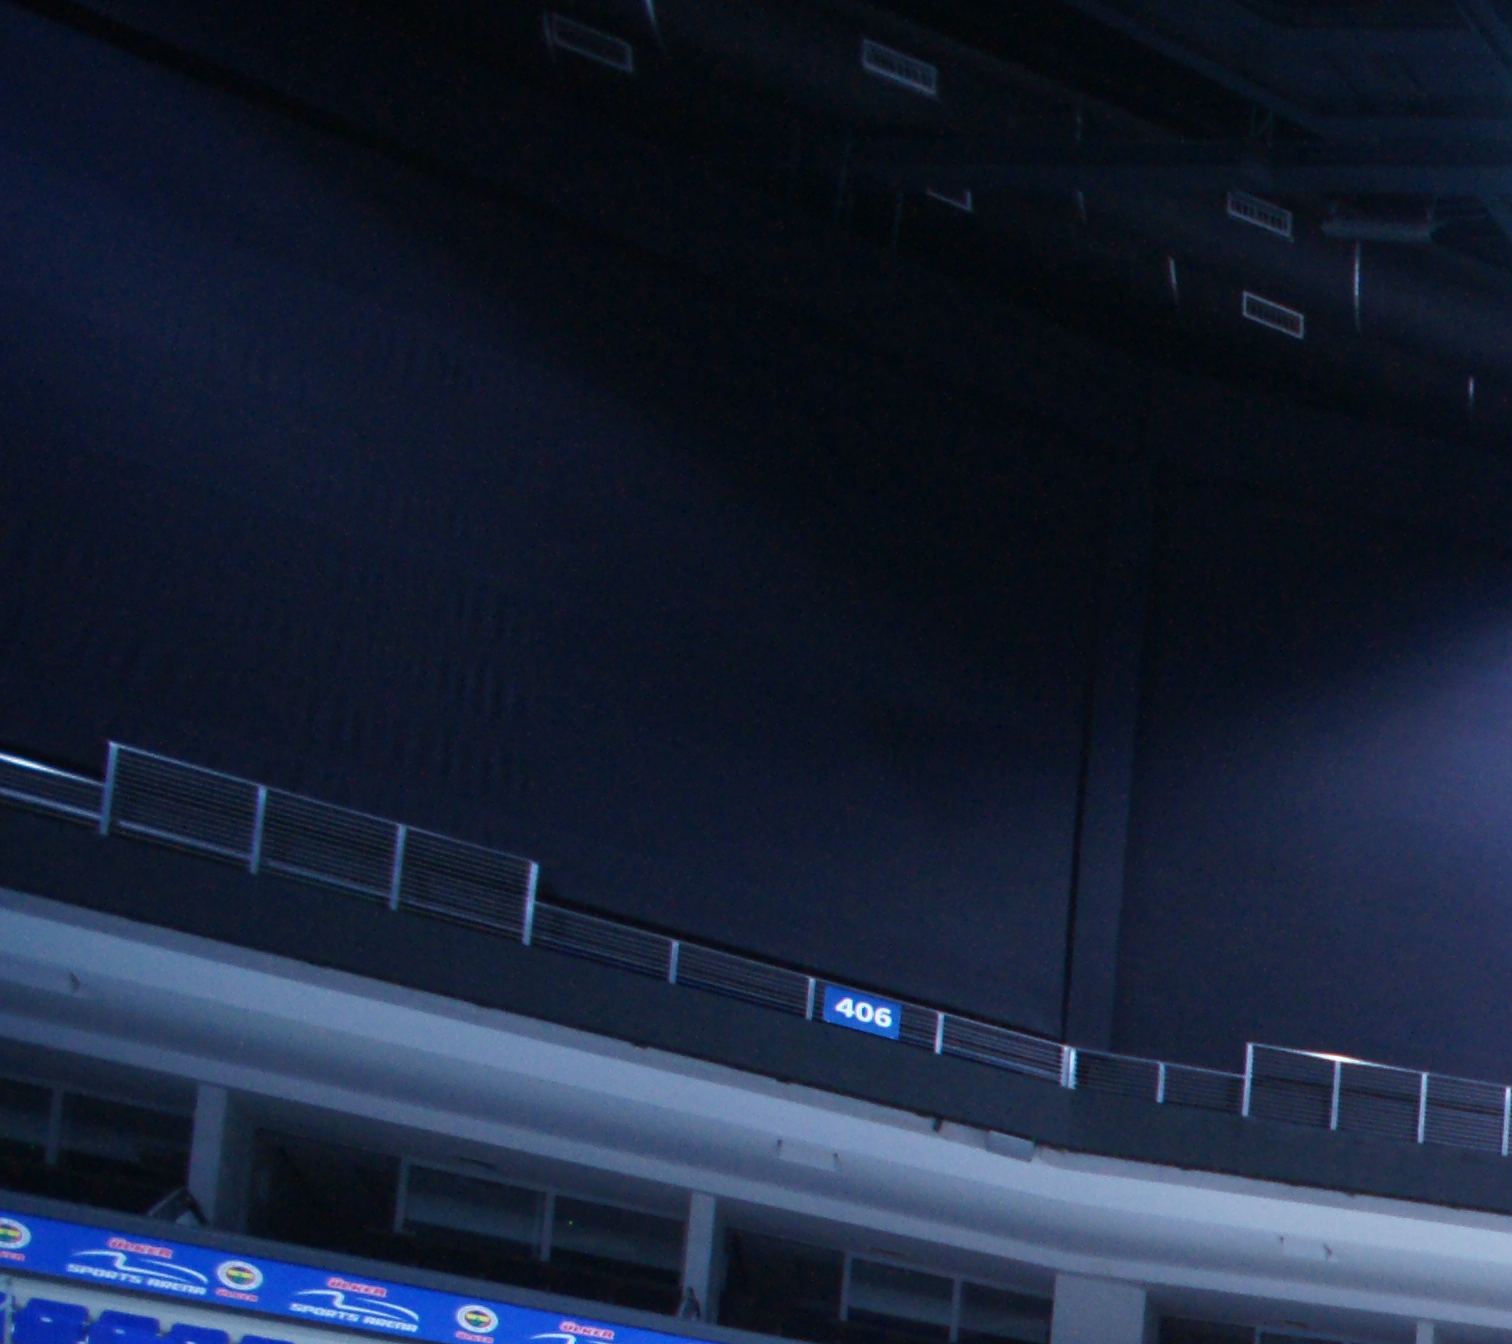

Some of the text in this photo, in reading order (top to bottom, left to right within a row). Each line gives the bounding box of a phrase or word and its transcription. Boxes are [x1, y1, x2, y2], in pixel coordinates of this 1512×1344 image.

[835, 997, 892, 1028] 406
[67, 1263, 140, 1284] SPORTS
[290, 1302, 357, 1322] SPORTS
